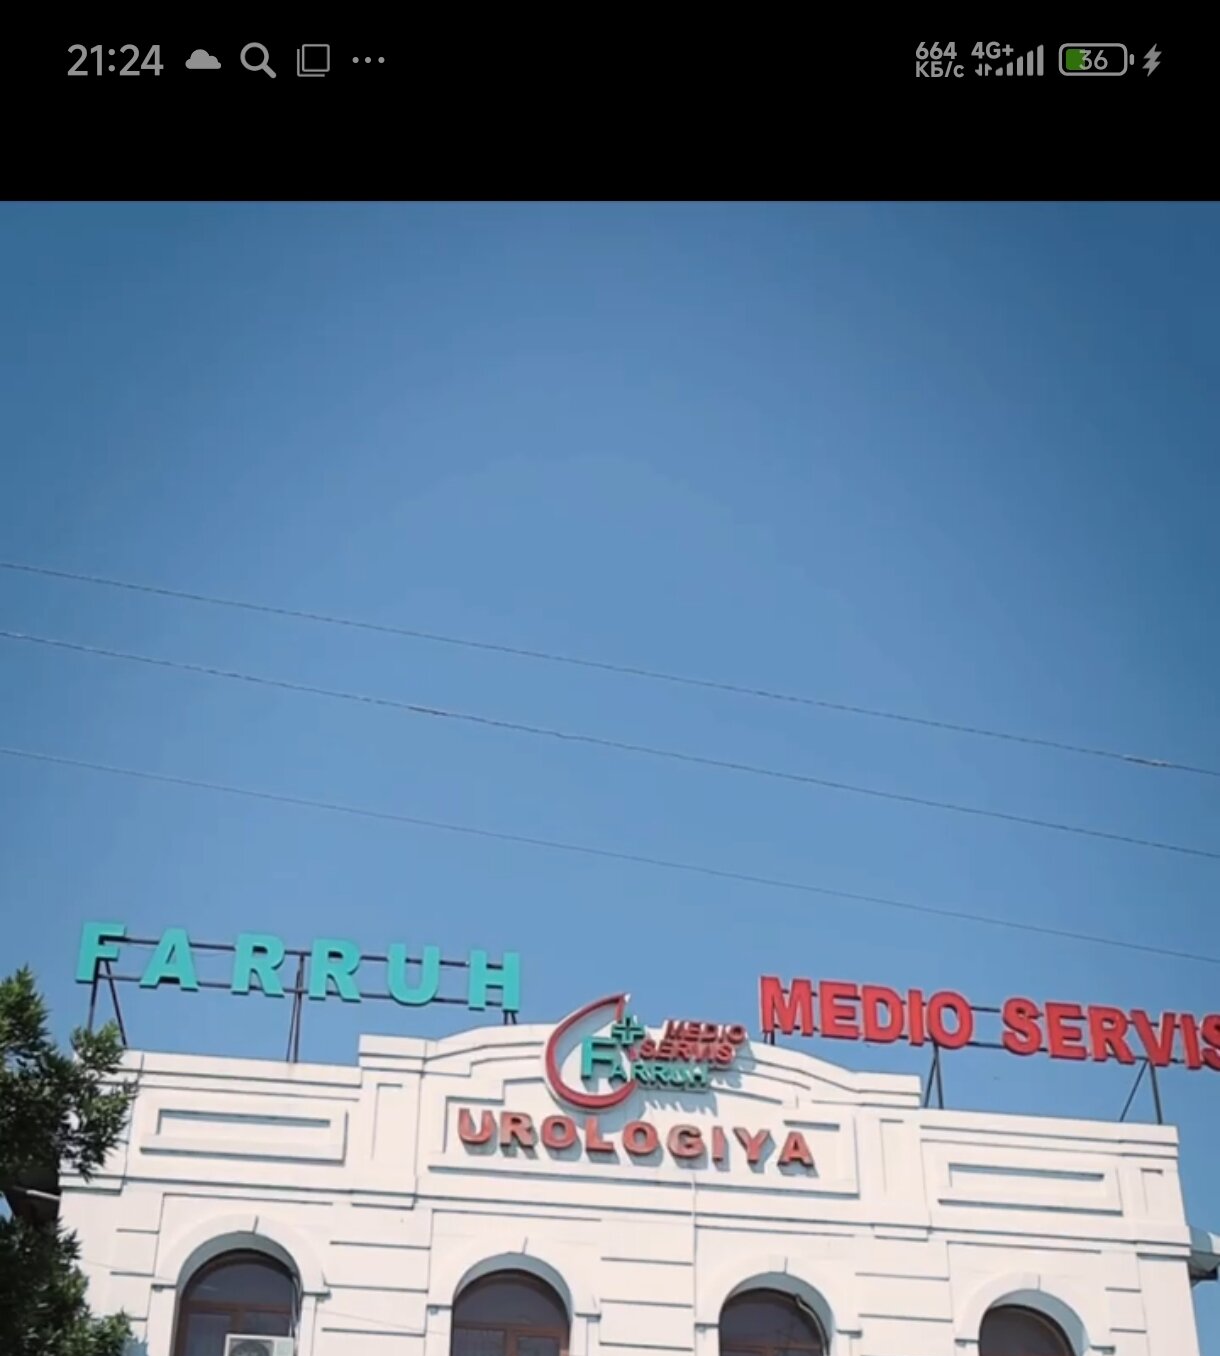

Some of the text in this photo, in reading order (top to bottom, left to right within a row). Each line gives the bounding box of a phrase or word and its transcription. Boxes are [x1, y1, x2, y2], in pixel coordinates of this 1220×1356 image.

[75, 921, 520, 1012] FARRUH
[664, 1020, 746, 1044] MEDIO
[760, 976, 975, 1050] MEDIO
[638, 1039, 736, 1066] SERVIS
[457, 1108, 815, 1168] UROLOGIYA
